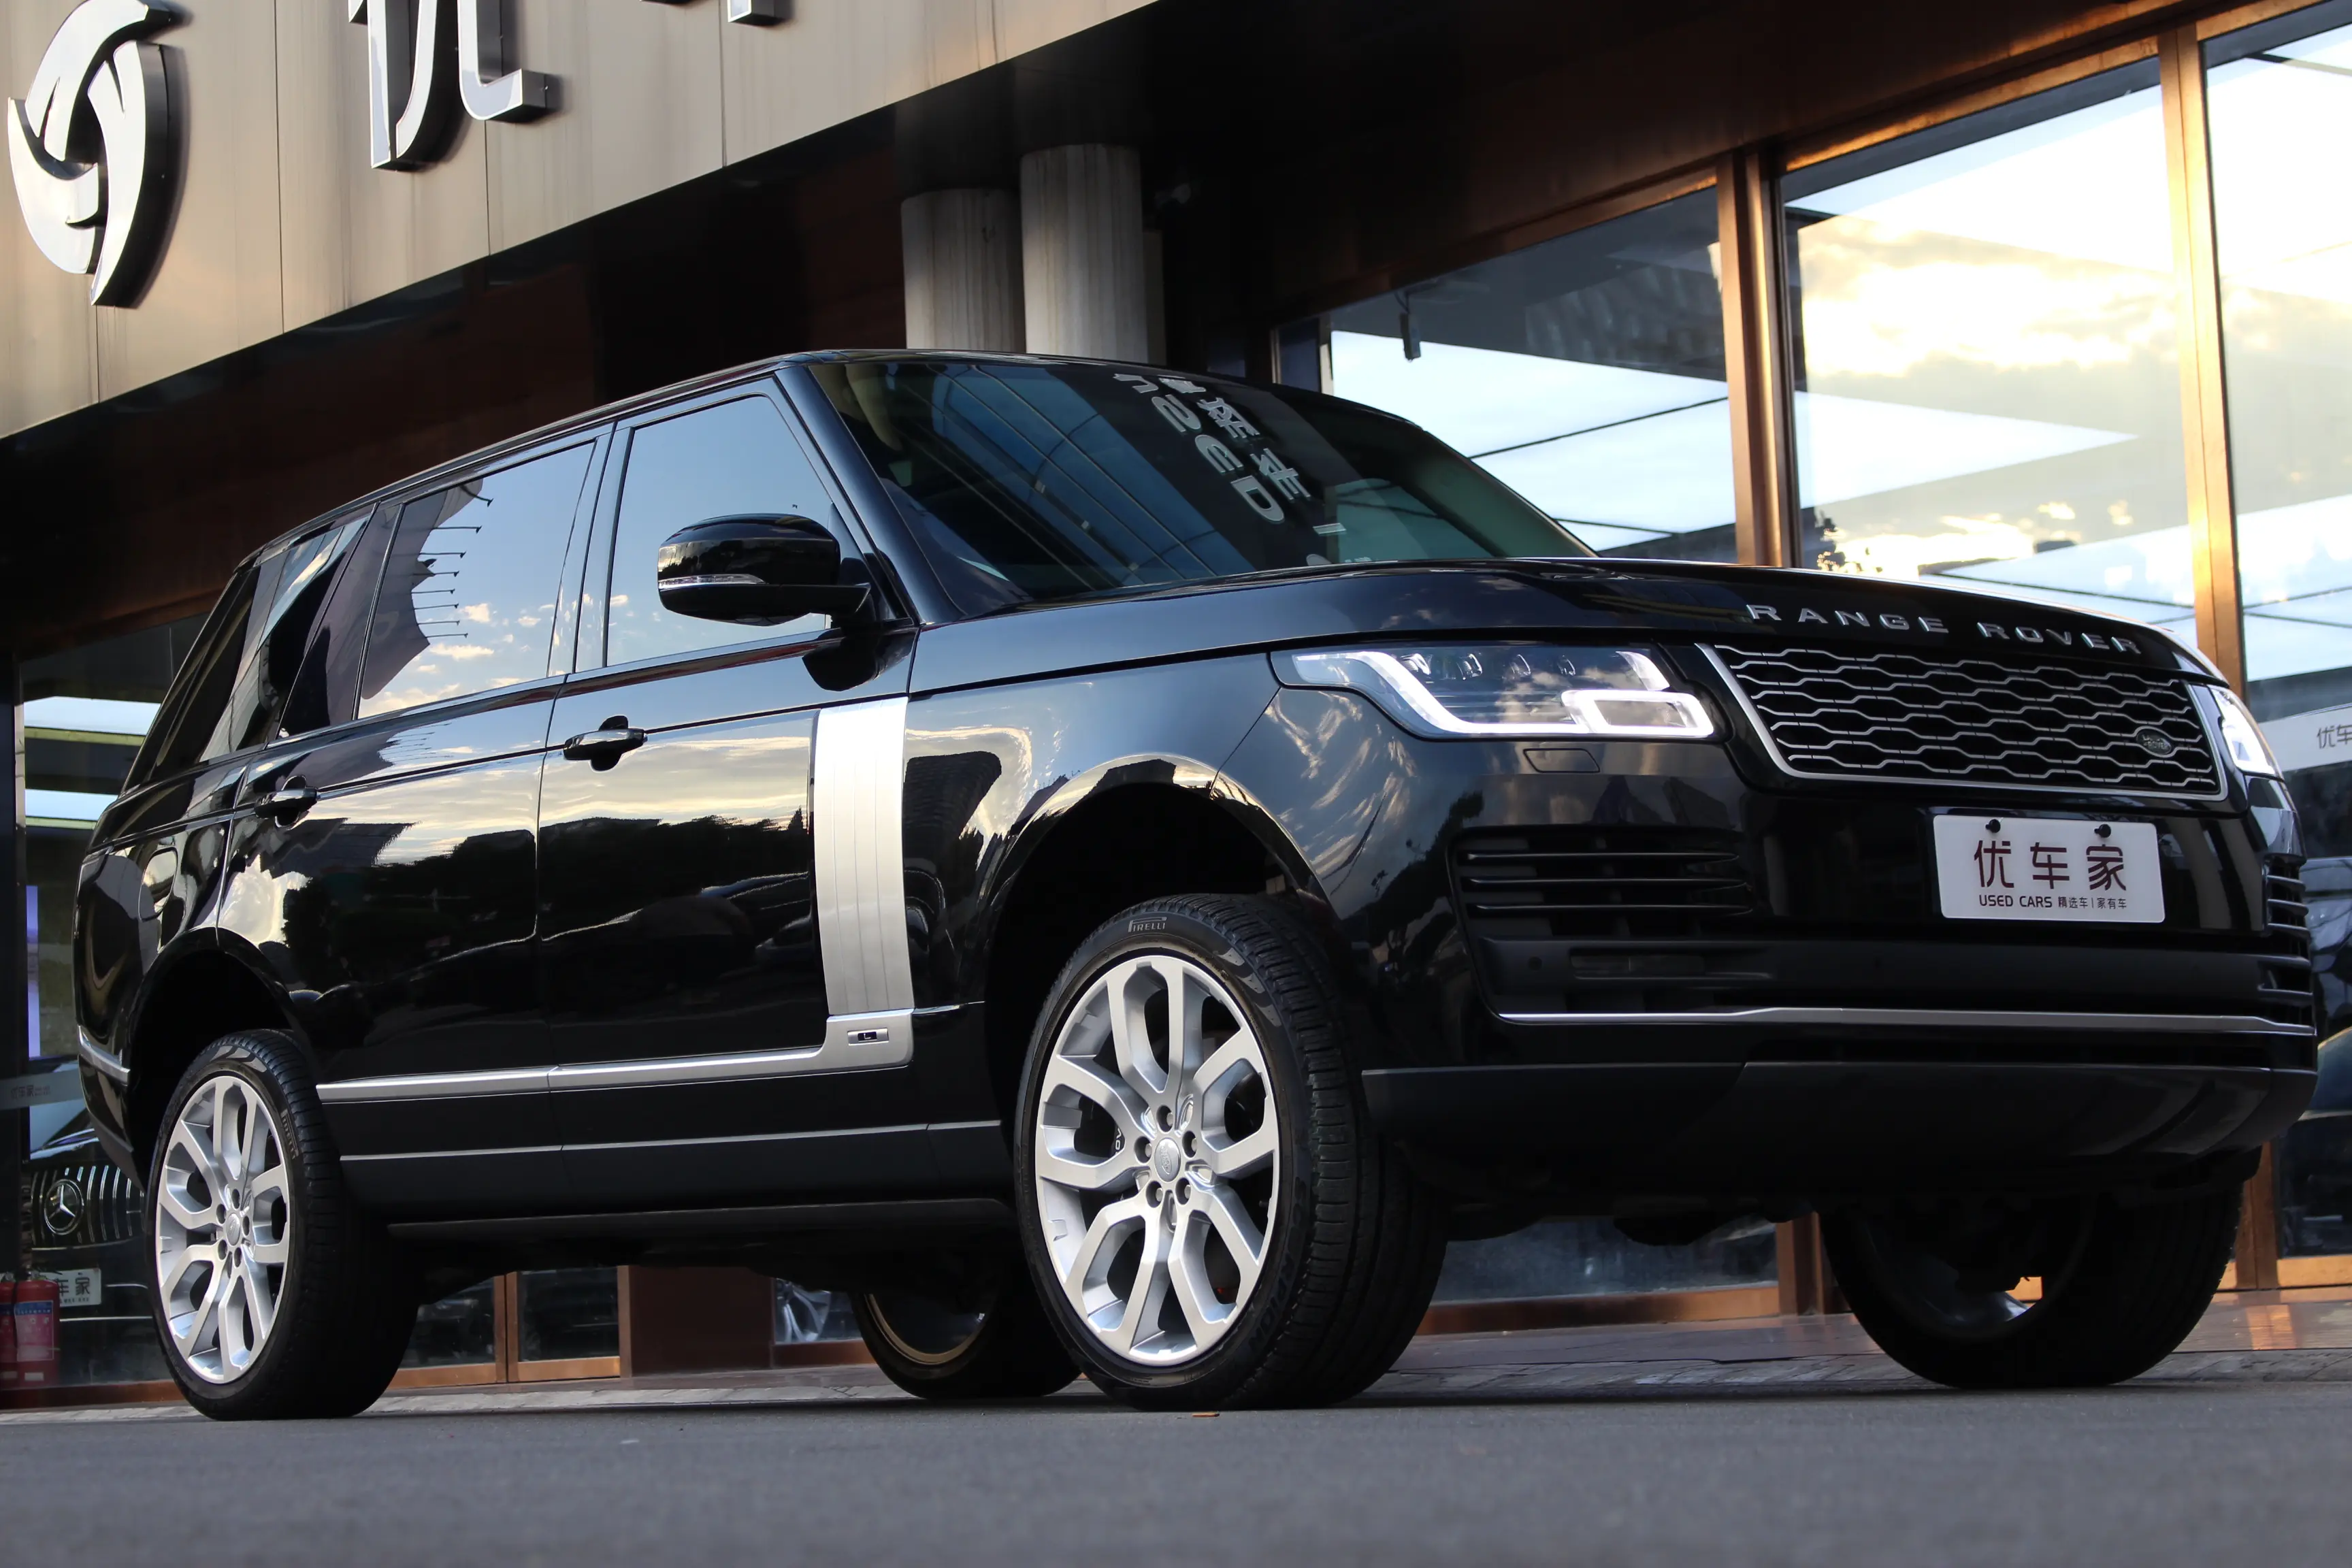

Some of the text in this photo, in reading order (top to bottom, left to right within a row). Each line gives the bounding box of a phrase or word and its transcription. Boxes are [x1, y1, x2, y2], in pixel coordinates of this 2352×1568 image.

[1746, 604, 2142, 654] RANGE ROVER
[1974, 840, 2126, 891] 优车家
[1979, 895, 2013, 906] USED
[2019, 896, 2053, 908] CARS
[1128, 917, 1167, 932] PIRELLI
